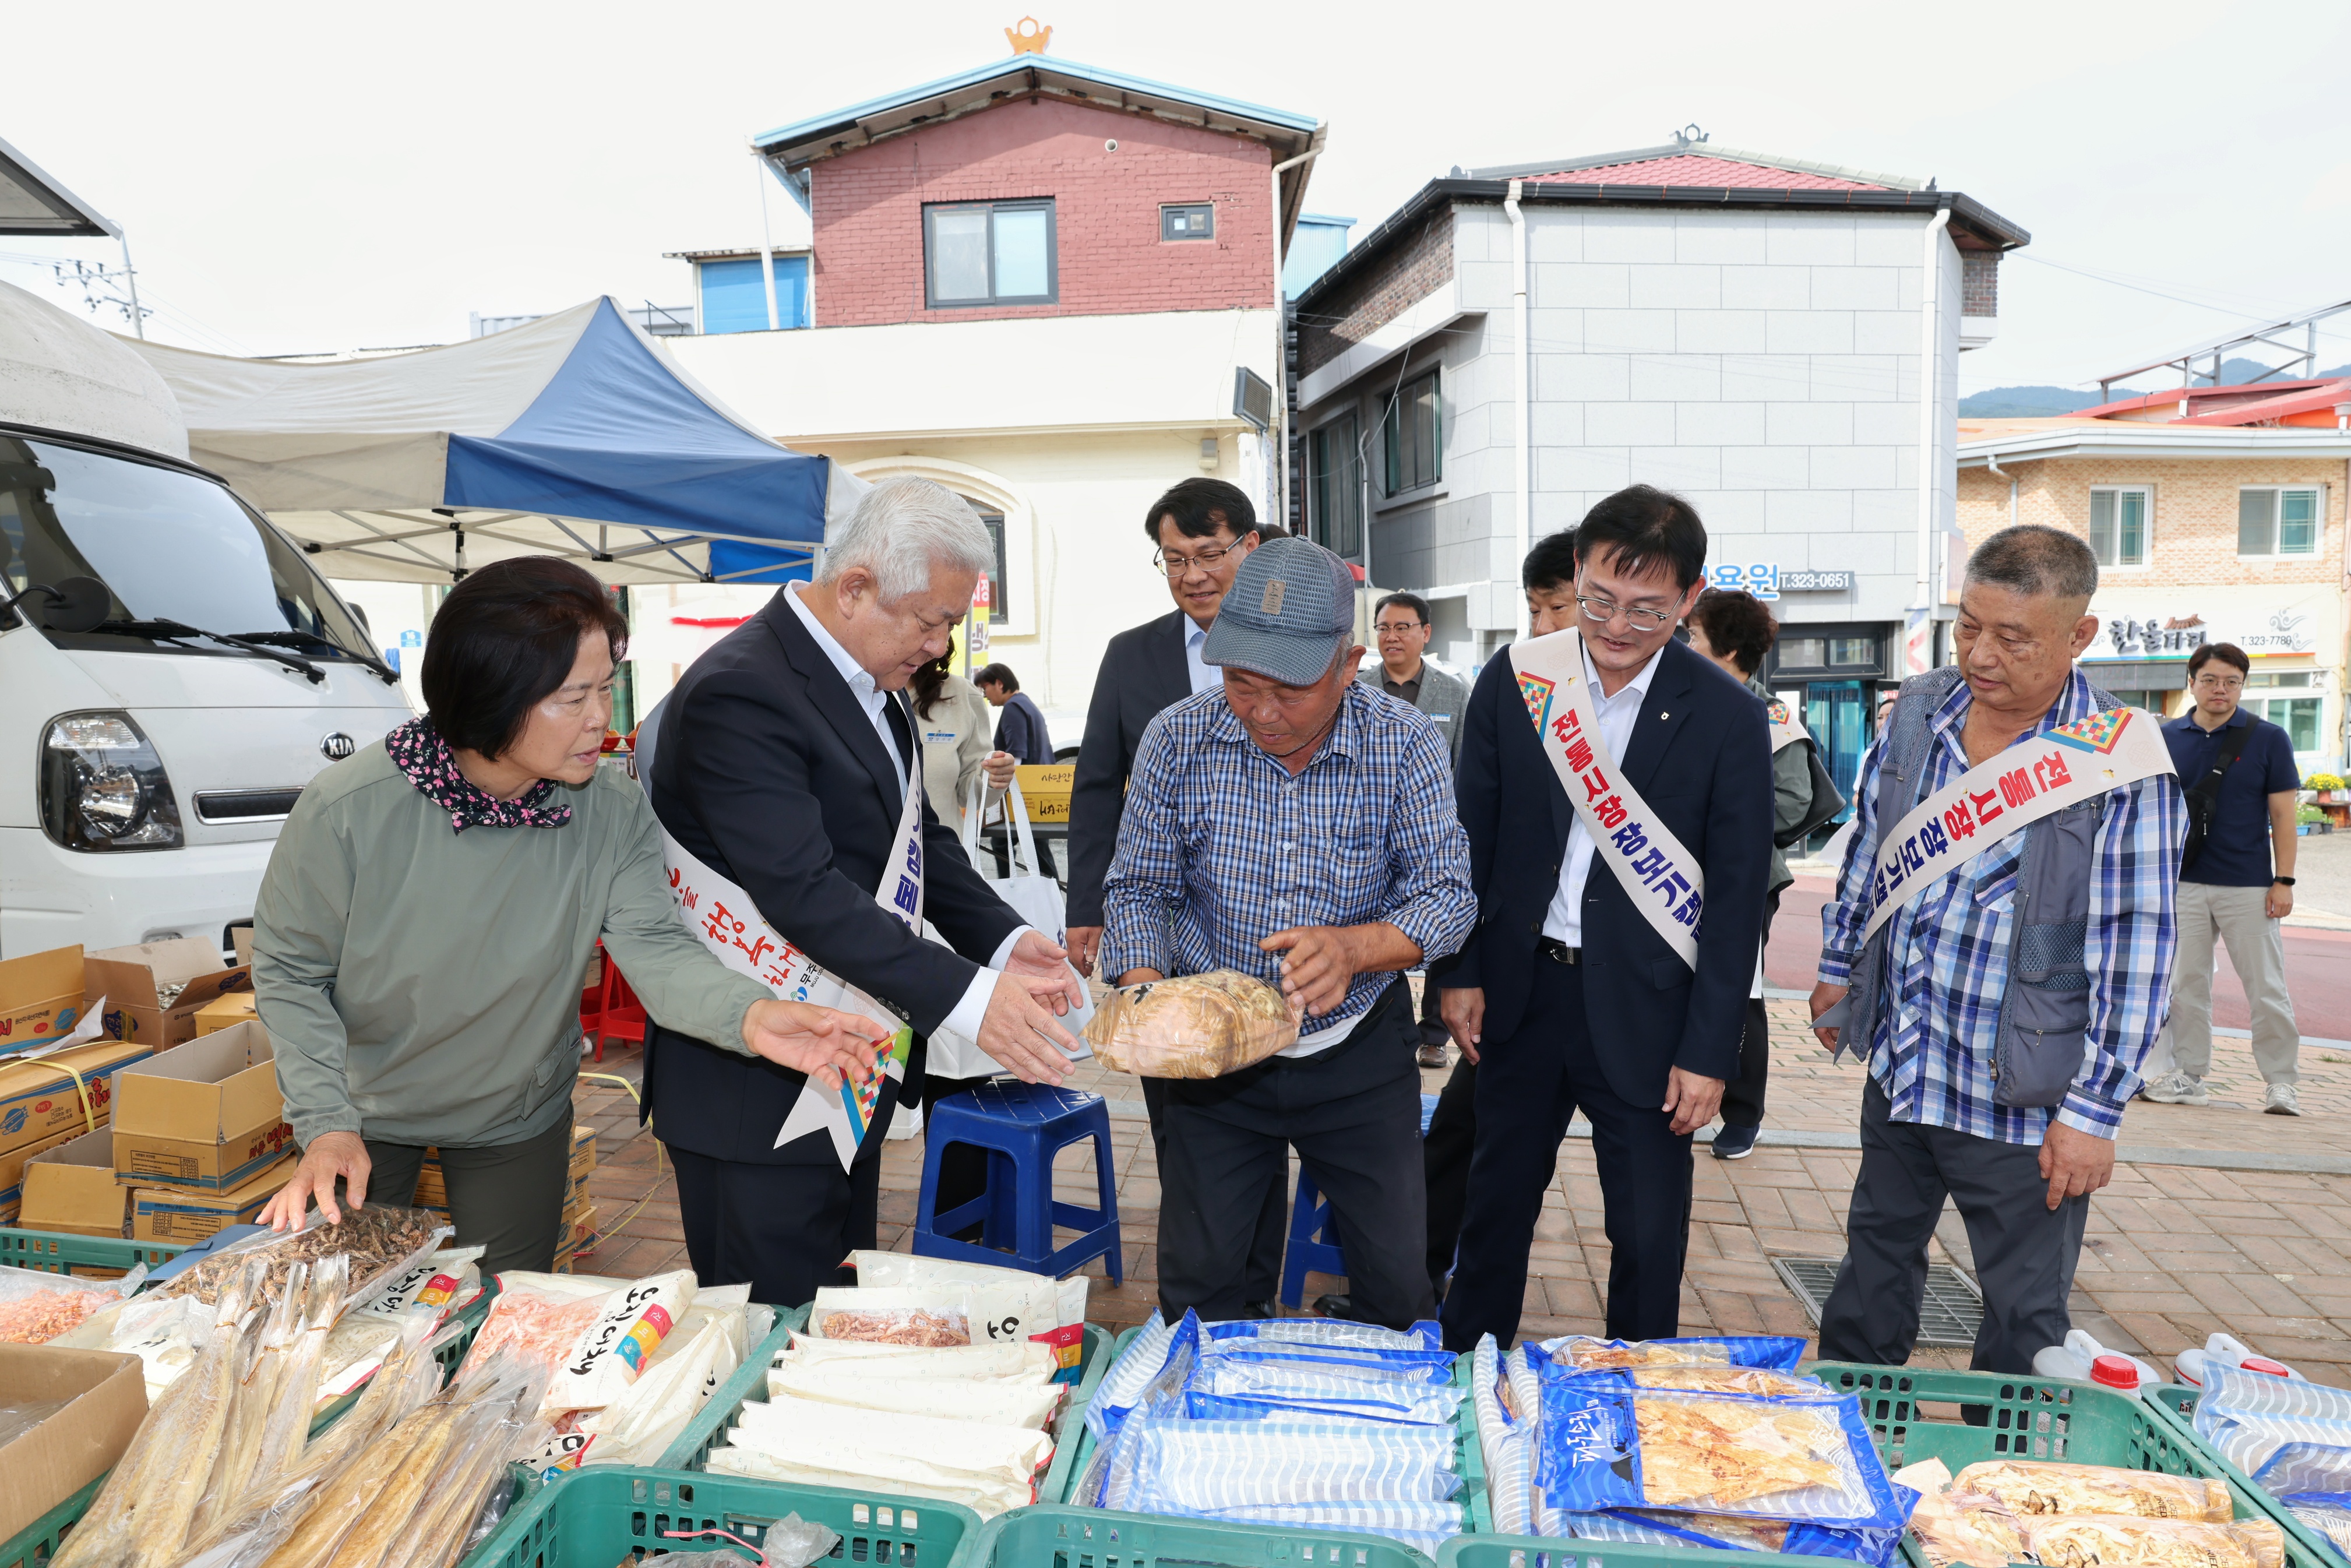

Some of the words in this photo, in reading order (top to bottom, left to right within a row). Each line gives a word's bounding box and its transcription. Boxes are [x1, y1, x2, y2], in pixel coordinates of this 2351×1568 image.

[1703, 564, 1777, 598] 용원
[1781, 573, 1849, 589] T.323-0651
[2109, 619, 2207, 654] 한울타리
[327, 738, 353, 755] KIA
[2154, 1496, 2167, 1517] DRIED
